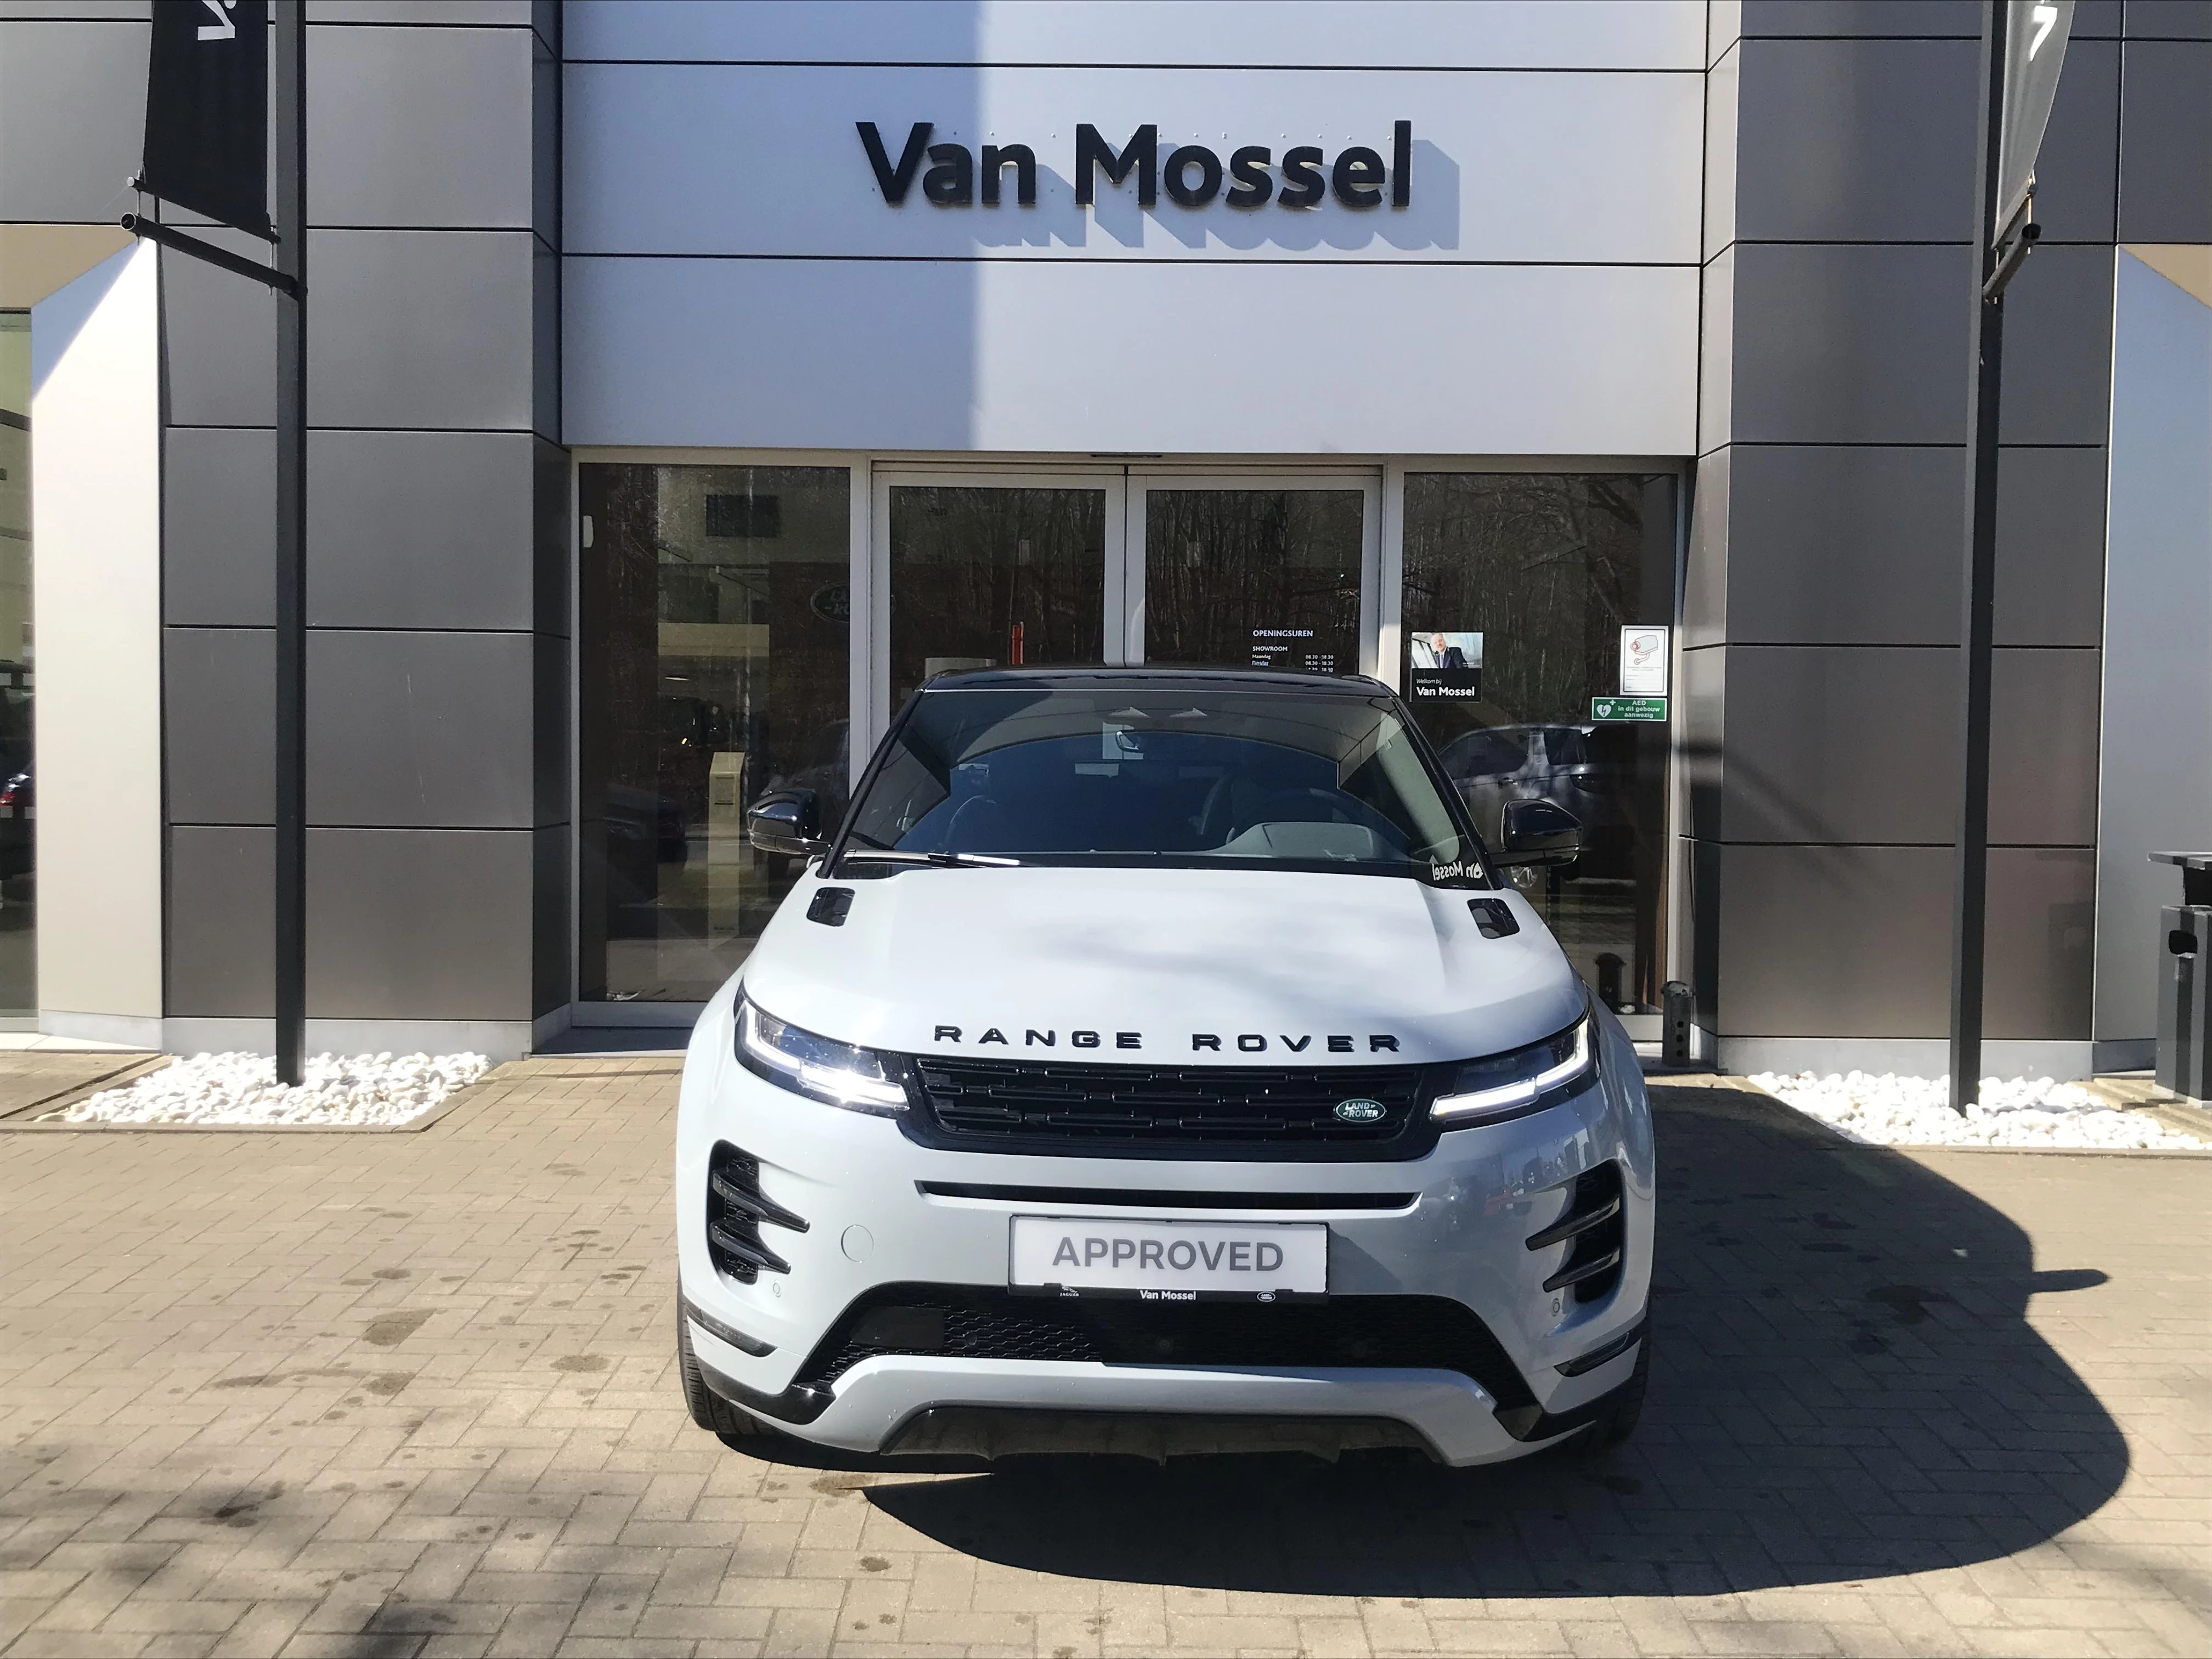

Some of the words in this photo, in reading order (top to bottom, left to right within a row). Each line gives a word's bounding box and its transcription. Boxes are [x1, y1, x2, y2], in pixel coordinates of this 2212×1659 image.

[856, 121, 1036, 206] Van
[1075, 120, 1412, 208] Mossel
[1416, 686, 1436, 696] Van
[1438, 686, 1475, 696] Mossel
[934, 1025, 1142, 1049] RANGE
[1192, 1034, 1400, 1052] ROVER
[1345, 1102, 1370, 1110] LAND
[1348, 1109, 1379, 1118] ROVER
[1052, 1237, 1283, 1272] APPROVED
[1140, 1290, 1159, 1299] Van
[1161, 1290, 1196, 1300] Mossel
